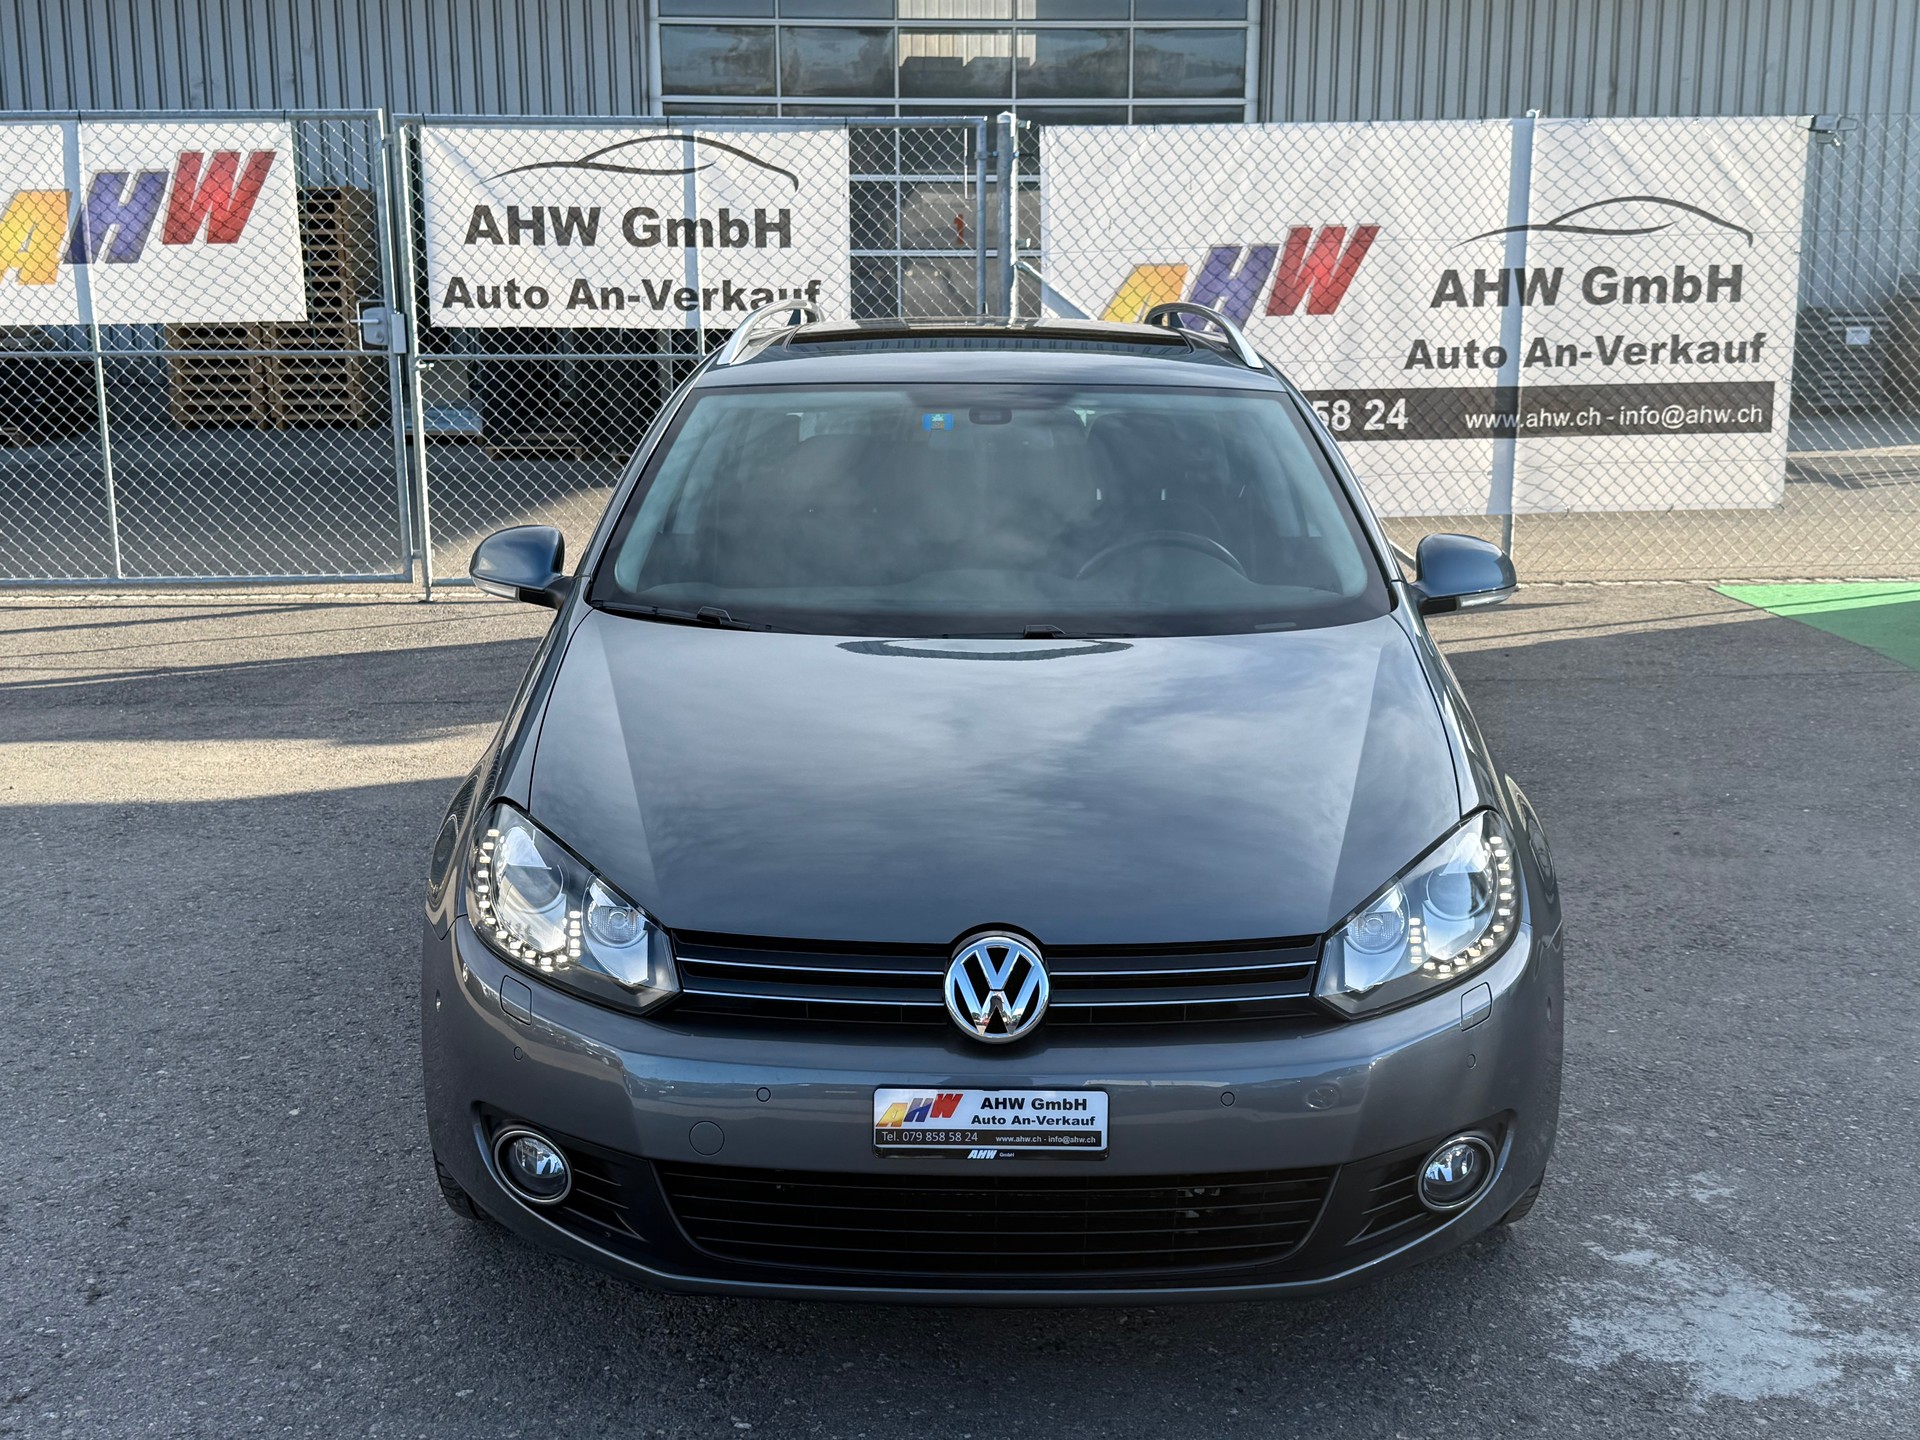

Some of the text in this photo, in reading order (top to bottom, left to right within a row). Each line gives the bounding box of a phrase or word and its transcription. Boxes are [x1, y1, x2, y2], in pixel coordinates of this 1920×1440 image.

[0, 149, 277, 285] AHW
[464, 204, 792, 249] AHW GmbH
[442, 276, 549, 310] Auto
[1429, 264, 1743, 308] AHW GmbH
[1404, 332, 1767, 370] Auto An-Verkauf
[1363, 398, 1409, 430] 24
[1465, 406, 1601, 429] www.ahw.ch
[1618, 403, 1763, 430] info@ahw.ch
[876, 1093, 963, 1127] AHW
[980, 1097, 1087, 1111] AHW GmbH
[882, 1131, 978, 1142] Tel. 079 858 58 24
[971, 1115, 1096, 1126] Auto An-Verkauf
[967, 1149, 997, 1159] AHW
[995, 1134, 1042, 1143] www.ahw.ch
[1048, 1135, 1096, 1145] info@ahw.ch
